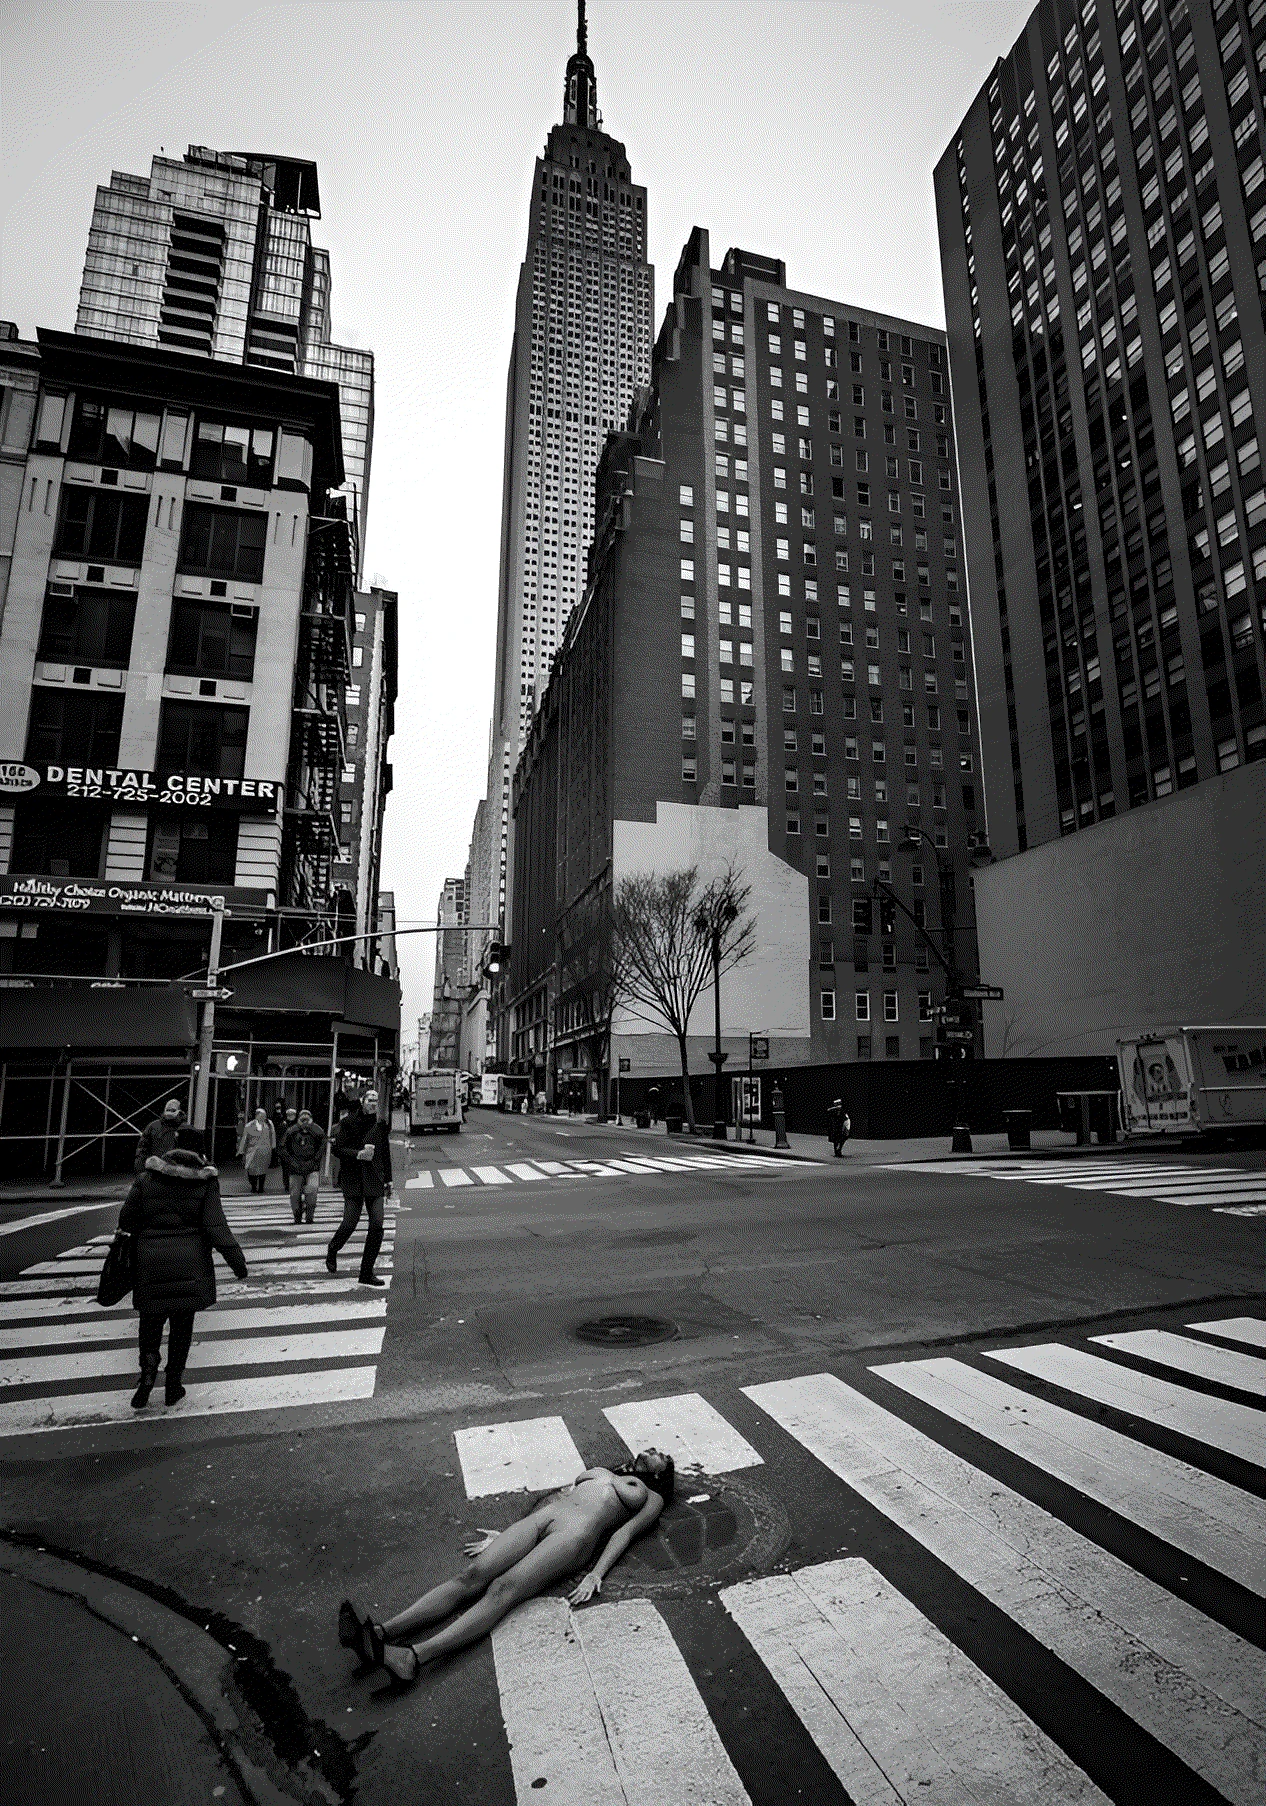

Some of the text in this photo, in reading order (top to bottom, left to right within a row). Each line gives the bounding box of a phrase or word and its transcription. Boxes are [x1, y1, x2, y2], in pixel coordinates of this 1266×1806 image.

[46, 765, 275, 798] DENTAL CENTER
[66, 783, 212, 806] 212-725-2002
